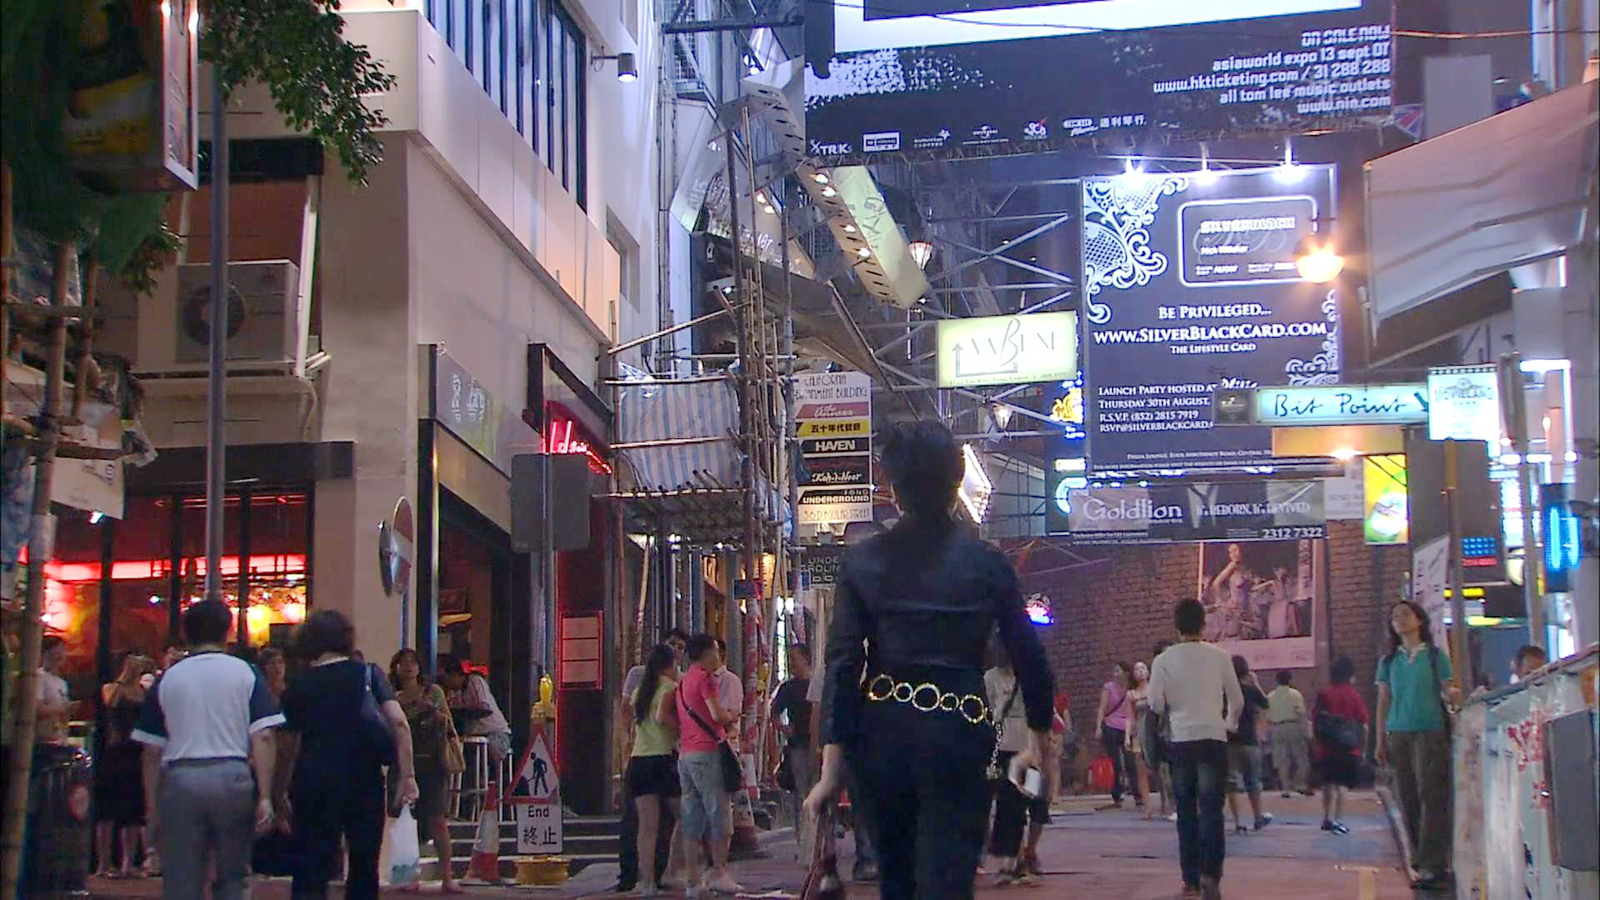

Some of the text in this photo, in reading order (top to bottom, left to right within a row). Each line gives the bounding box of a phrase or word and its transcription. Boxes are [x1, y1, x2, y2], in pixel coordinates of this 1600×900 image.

[1213, 41, 1390, 71] asiaworld expo 13 sept 07
[1153, 68, 1298, 93] www.hkticketing.com
[1331, 61, 1360, 78] 288
[1362, 58, 1391, 75] 288
[1220, 76, 1391, 105] all tom lee music outlets
[1297, 95, 1391, 114] www.nin.com
[1274, 393, 1323, 417] Bit
[1335, 393, 1407, 415] Point
[1155, 411, 1175, 421] 2815
[1177, 410, 1199, 420] 7919
[815, 440, 856, 452] HAVEN
[803, 495, 869, 504] UNDERGROUND
[1083, 498, 1183, 521] Goldlion
[1262, 527, 1291, 539] 2312
[1294, 527, 1323, 538] 7322
[808, 555, 840, 565] UNDE
[800, 564, 841, 573] GROUN
[528, 804, 550, 818] End
[523, 826, 557, 848] 終止
